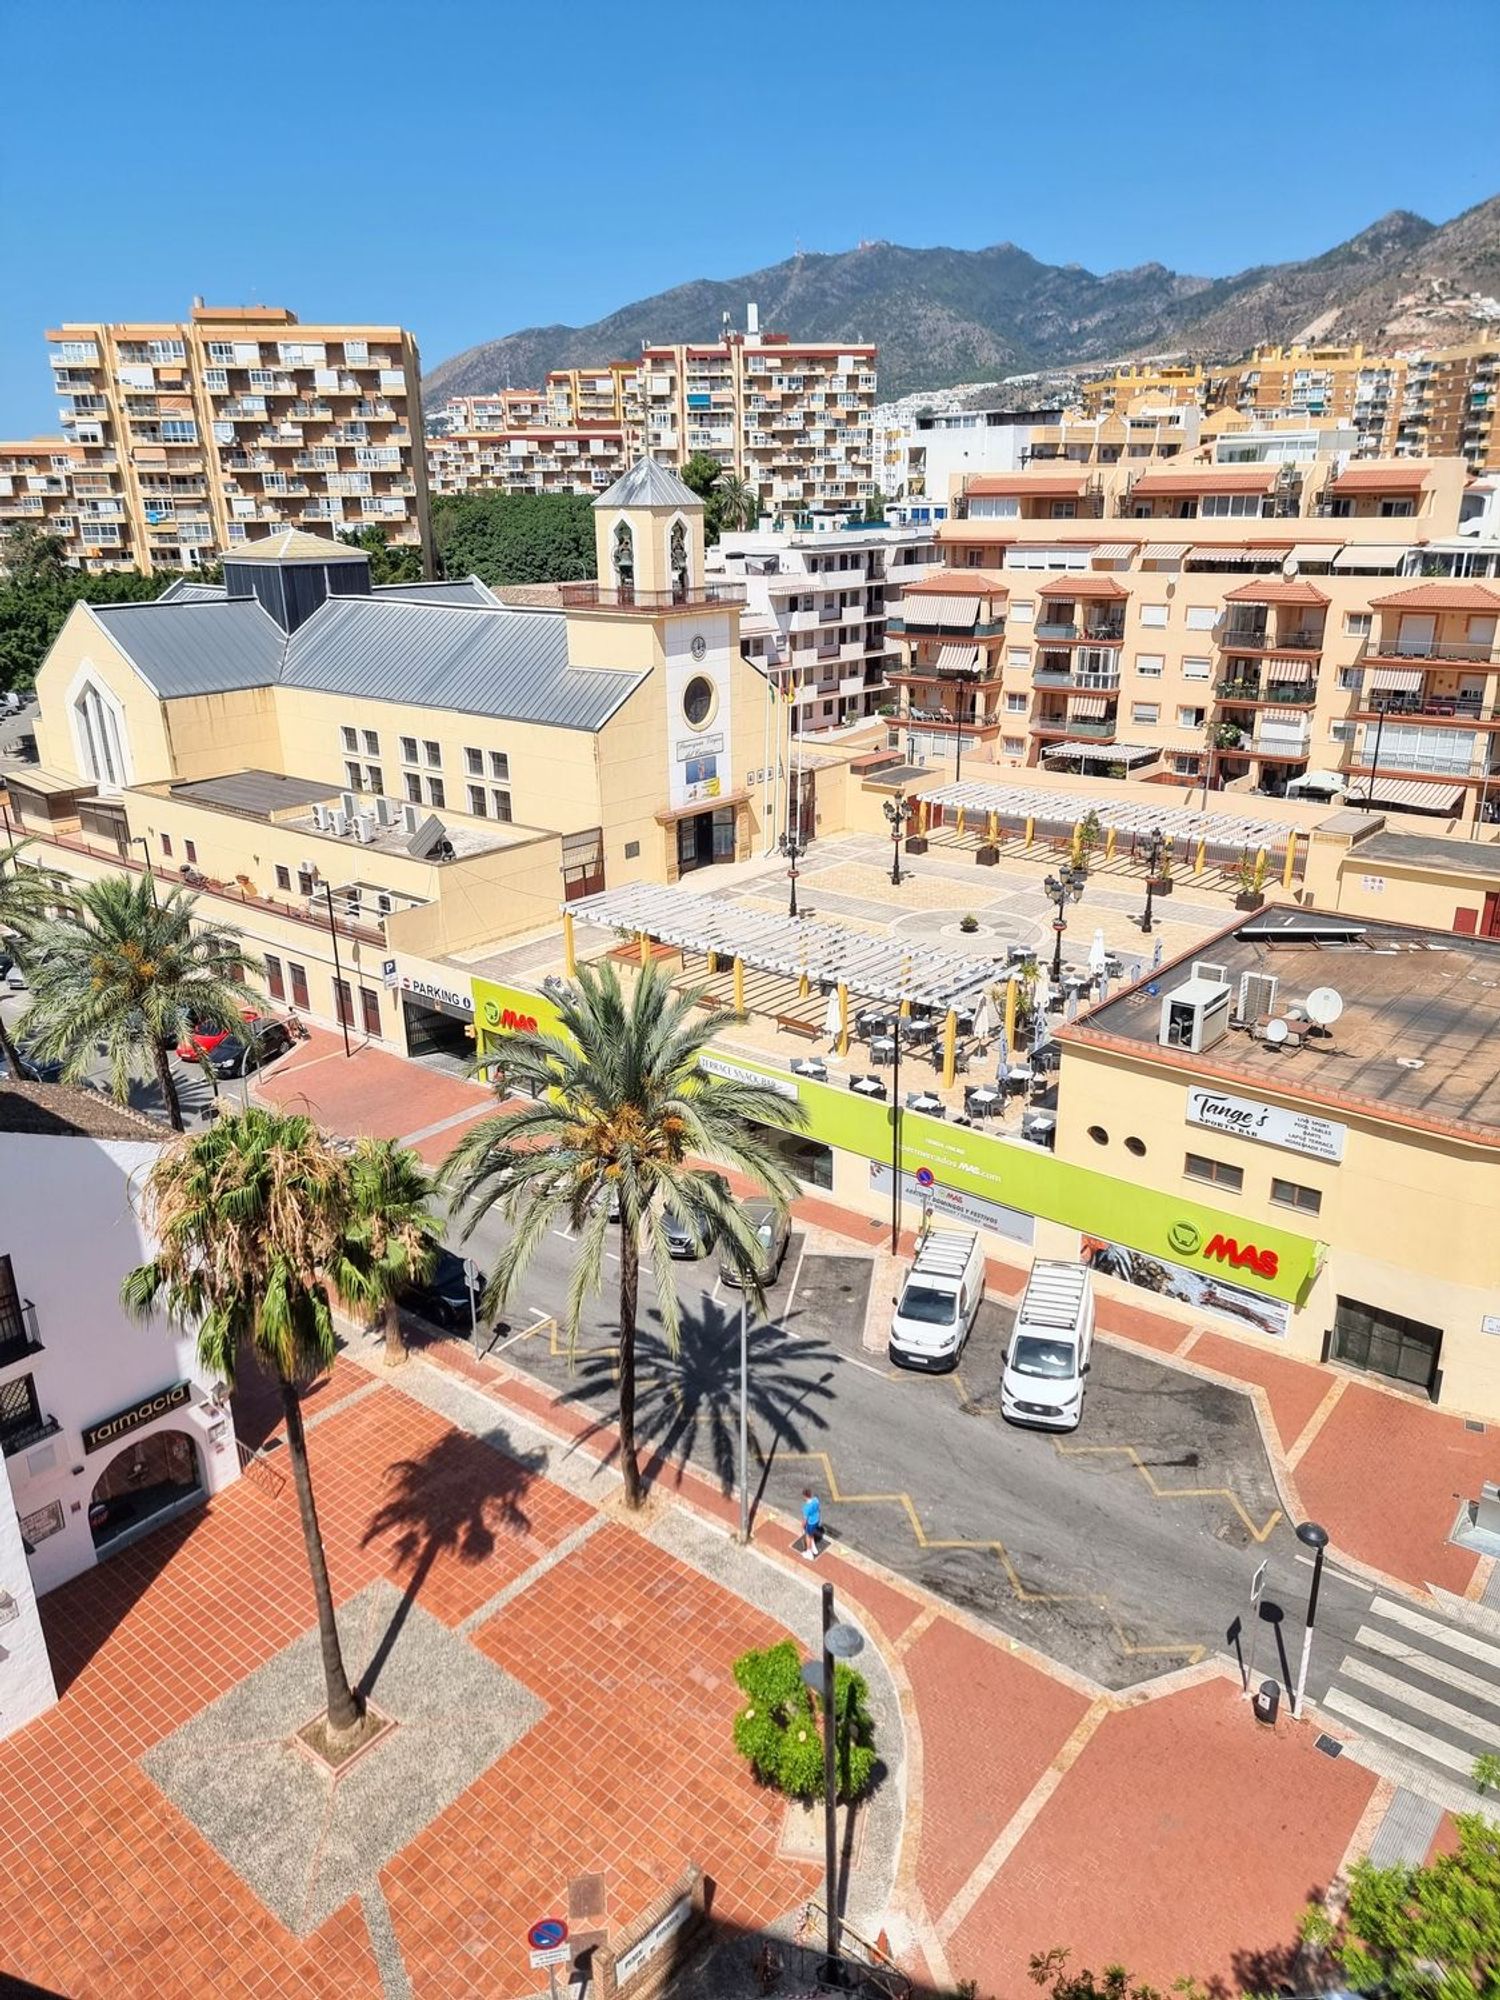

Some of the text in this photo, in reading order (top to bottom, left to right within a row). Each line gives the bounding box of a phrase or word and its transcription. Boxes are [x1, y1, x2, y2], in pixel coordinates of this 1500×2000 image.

[413, 980, 460, 1006] PARKING
[500, 1008, 538, 1033] MAS
[702, 1057, 776, 1089] TERRACE SNACK BAR
[1194, 1093, 1269, 1128] Tange's
[1199, 1117, 1258, 1138] SPORTS BAR
[1294, 1122, 1332, 1136] POOL TABLES
[1303, 1130, 1322, 1140] DARTS
[1284, 1138, 1337, 1156] HOMEMADE FOOD
[1308, 1138, 1334, 1149] TERRACE
[946, 1192, 963, 1204] MAS
[932, 1197, 964, 1213] DOMINGOS
[970, 1209, 998, 1225] FESTIVOS
[1203, 1234, 1278, 1280] MAS
